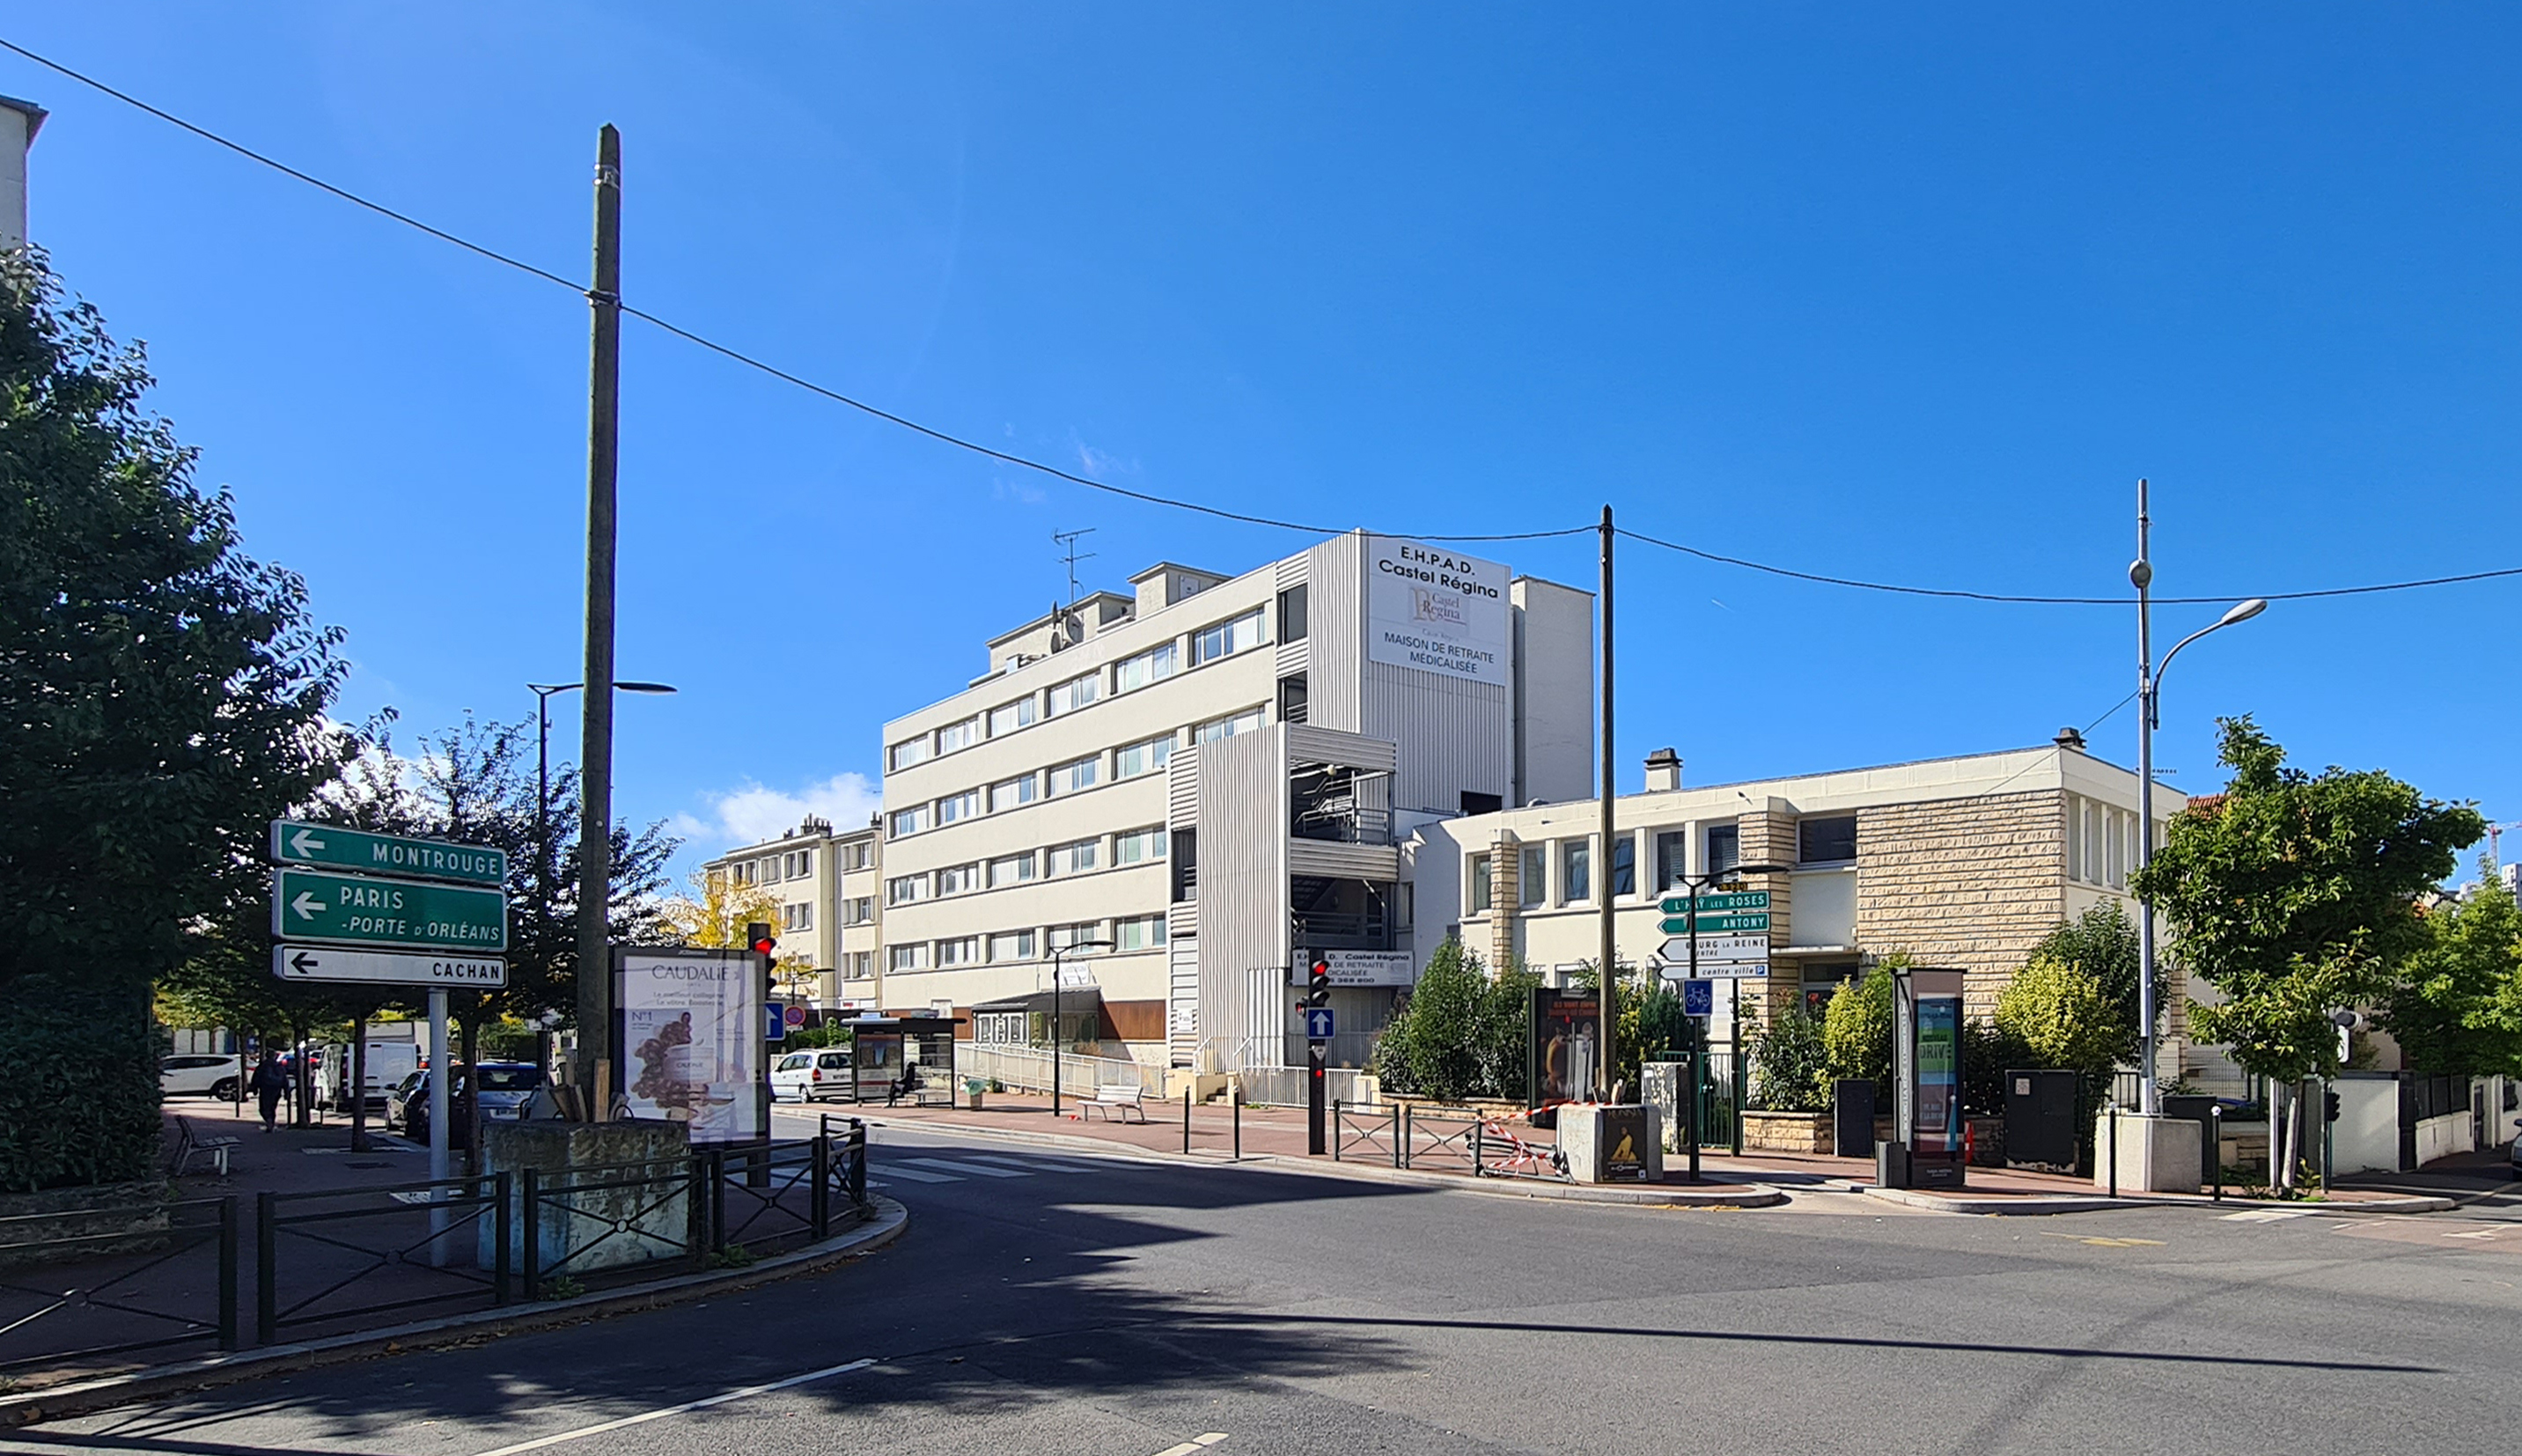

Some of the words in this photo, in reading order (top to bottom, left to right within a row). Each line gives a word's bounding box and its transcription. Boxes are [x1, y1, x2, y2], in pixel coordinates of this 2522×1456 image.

[1401, 546, 1475, 576] E.H.P.A.D.
[1379, 559, 1435, 584] Castel
[1440, 576, 1498, 599] Régina
[1431, 592, 1460, 608] Castel
[1385, 631, 1429, 651] MAISON
[1431, 641, 1445, 654] DE
[1447, 644, 1495, 664] RETRAITE
[1409, 651, 1478, 673] MÉDICALISÉE
[372, 842, 499, 874] MONTROUGE
[340, 886, 404, 909] PARIS
[1728, 894, 1765, 907] ROSES
[1722, 916, 1765, 929] ANTONY
[1734, 938, 1766, 948] REINE
[432, 962, 500, 979] CACHAN
